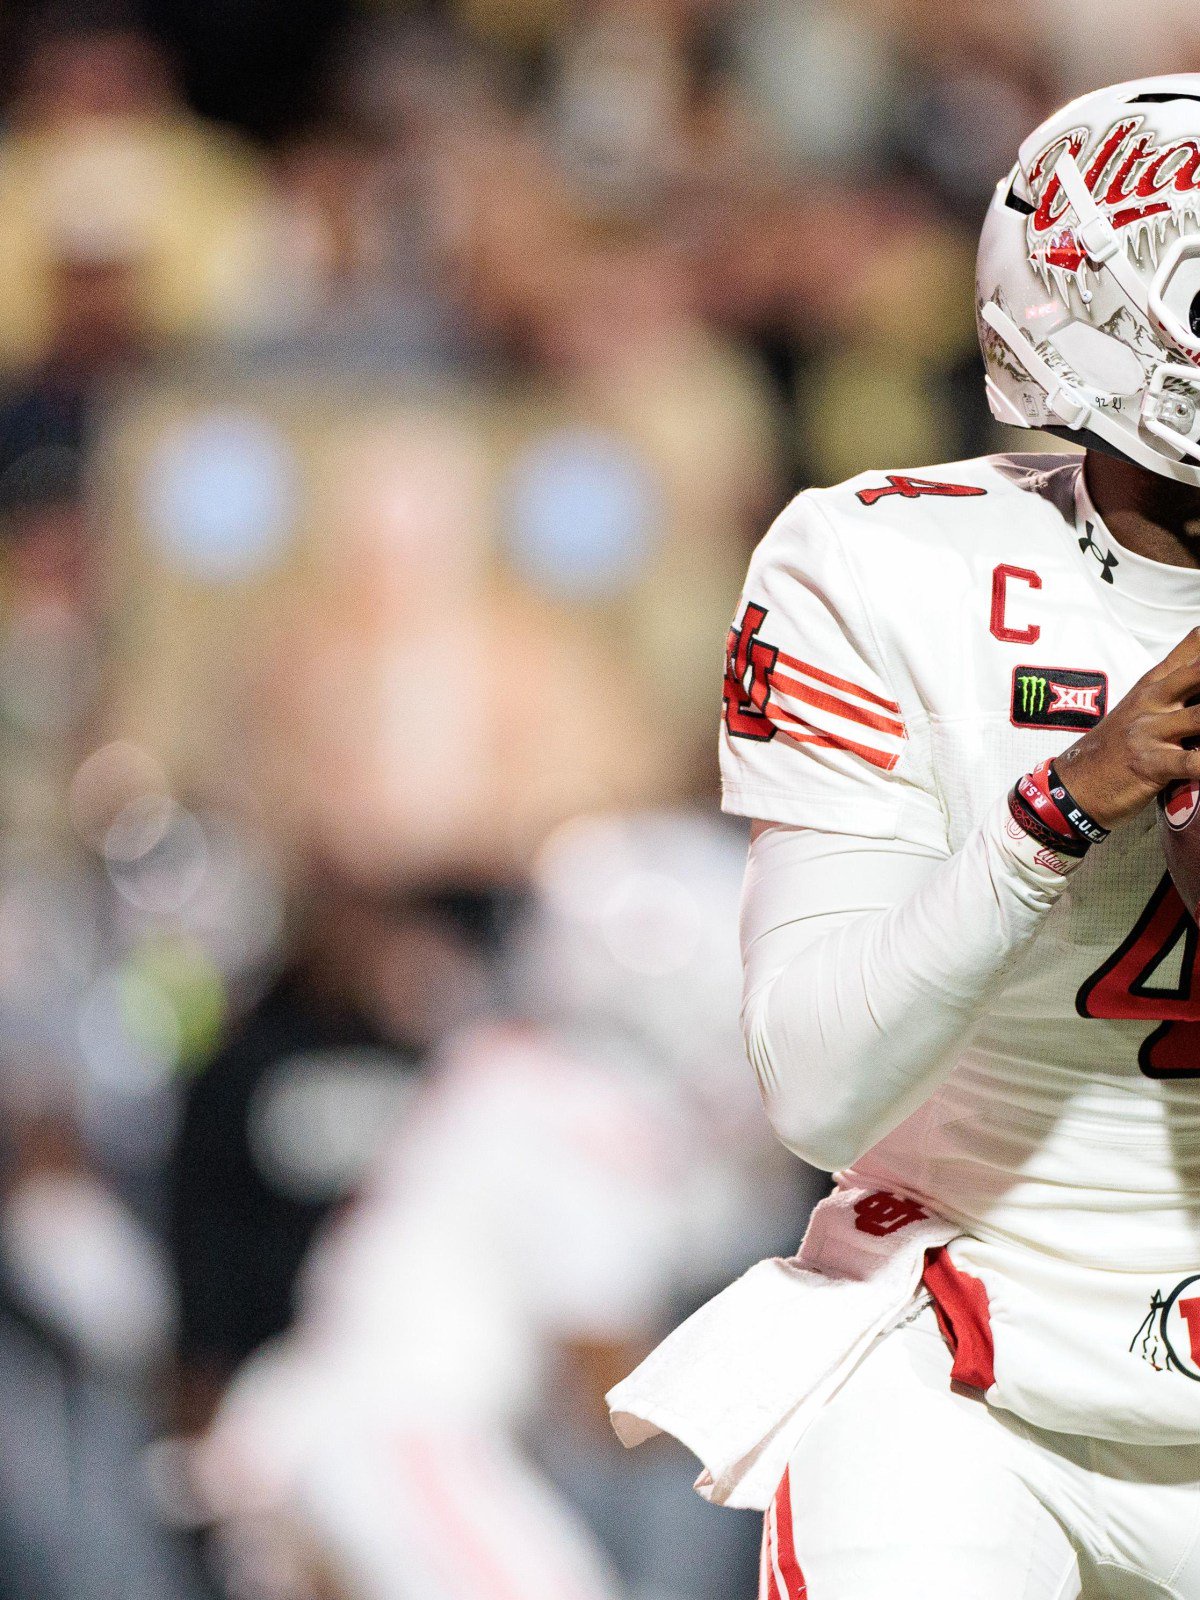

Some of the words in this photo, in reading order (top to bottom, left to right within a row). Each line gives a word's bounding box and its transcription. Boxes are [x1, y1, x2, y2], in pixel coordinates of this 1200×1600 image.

[855, 475, 988, 506] 4
[989, 563, 1043, 645] C
[1051, 684, 1099, 712] XII
